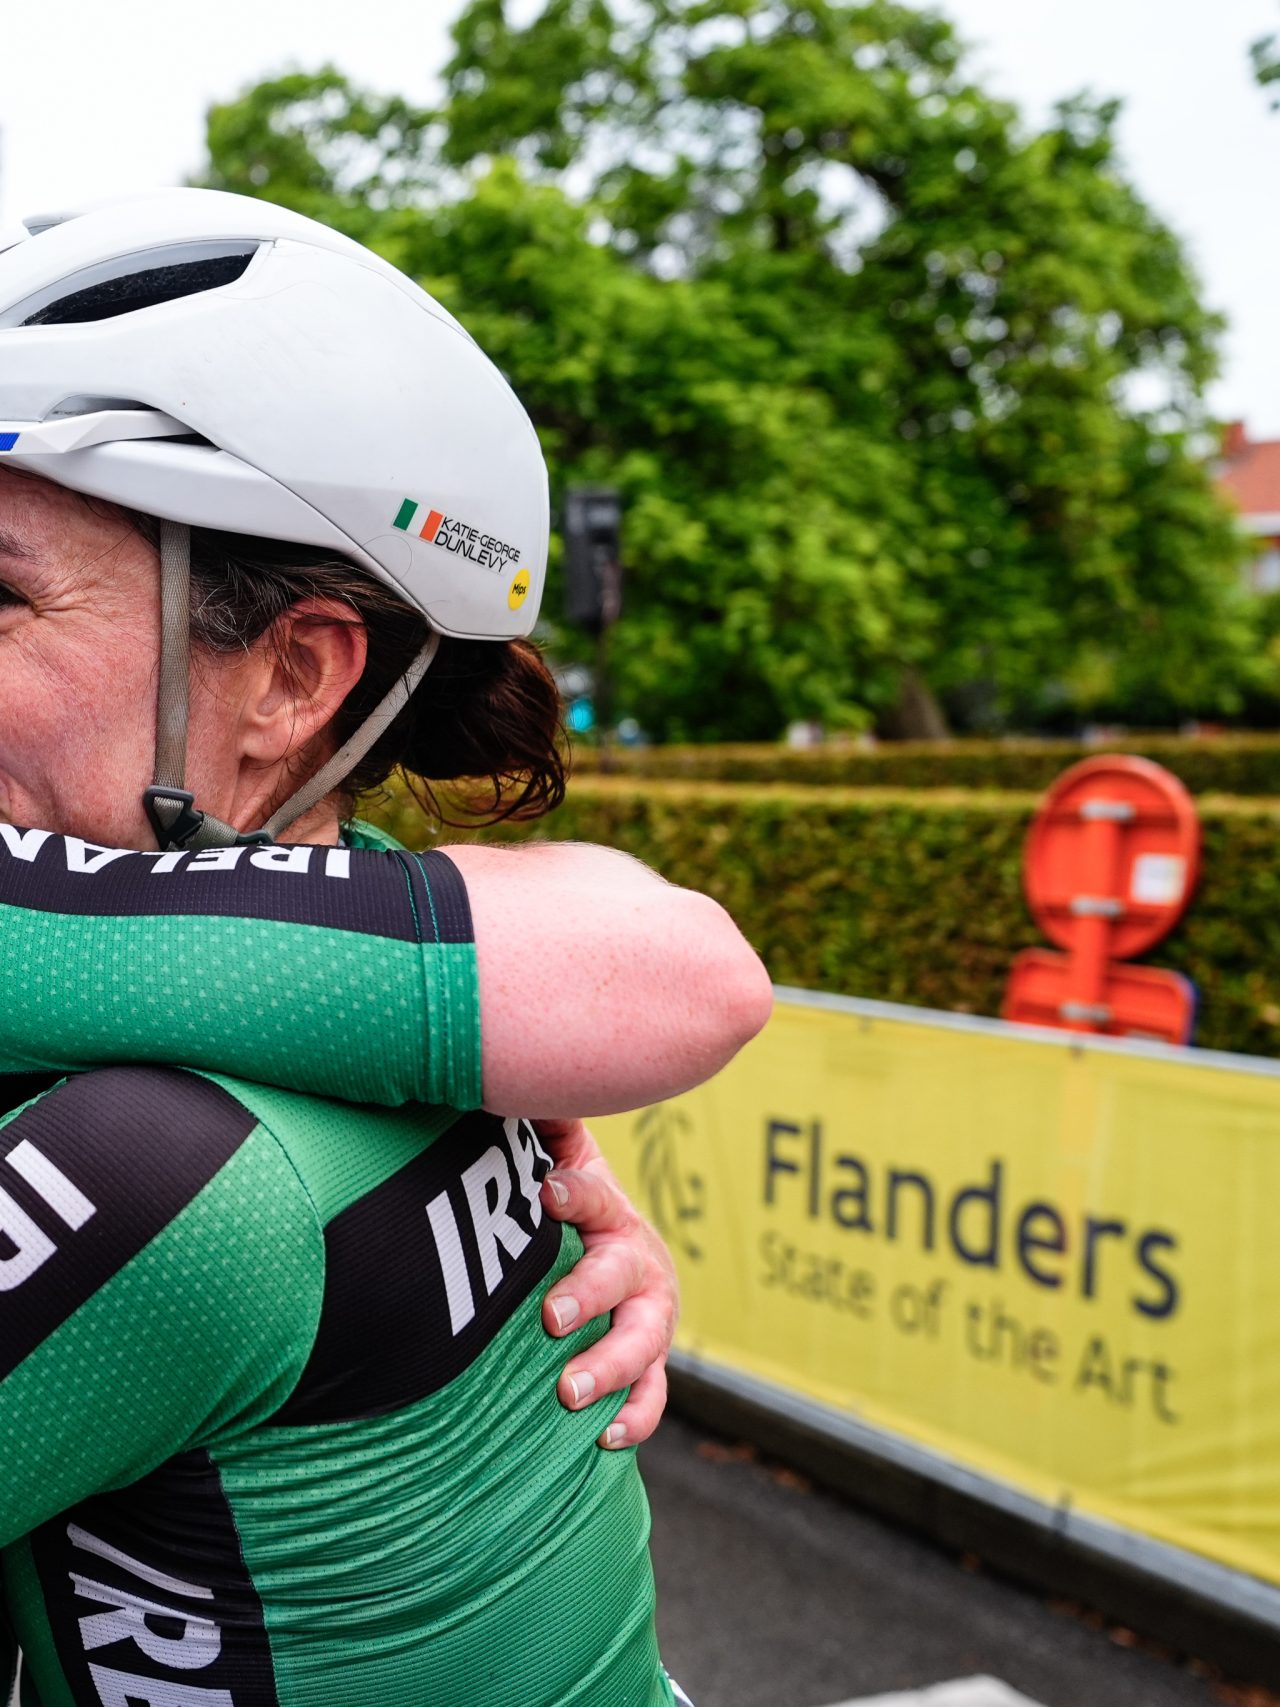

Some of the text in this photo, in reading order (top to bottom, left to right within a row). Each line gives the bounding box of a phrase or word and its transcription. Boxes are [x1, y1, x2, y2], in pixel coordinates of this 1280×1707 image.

[434, 530, 508, 573] DUNLEVY
[441, 516, 521, 563] KATIE-GEORGE
[425, 1117, 554, 1336] IRE
[761, 1114, 1182, 1321] Flanders
[758, 1230, 1180, 1427] State of the Art
